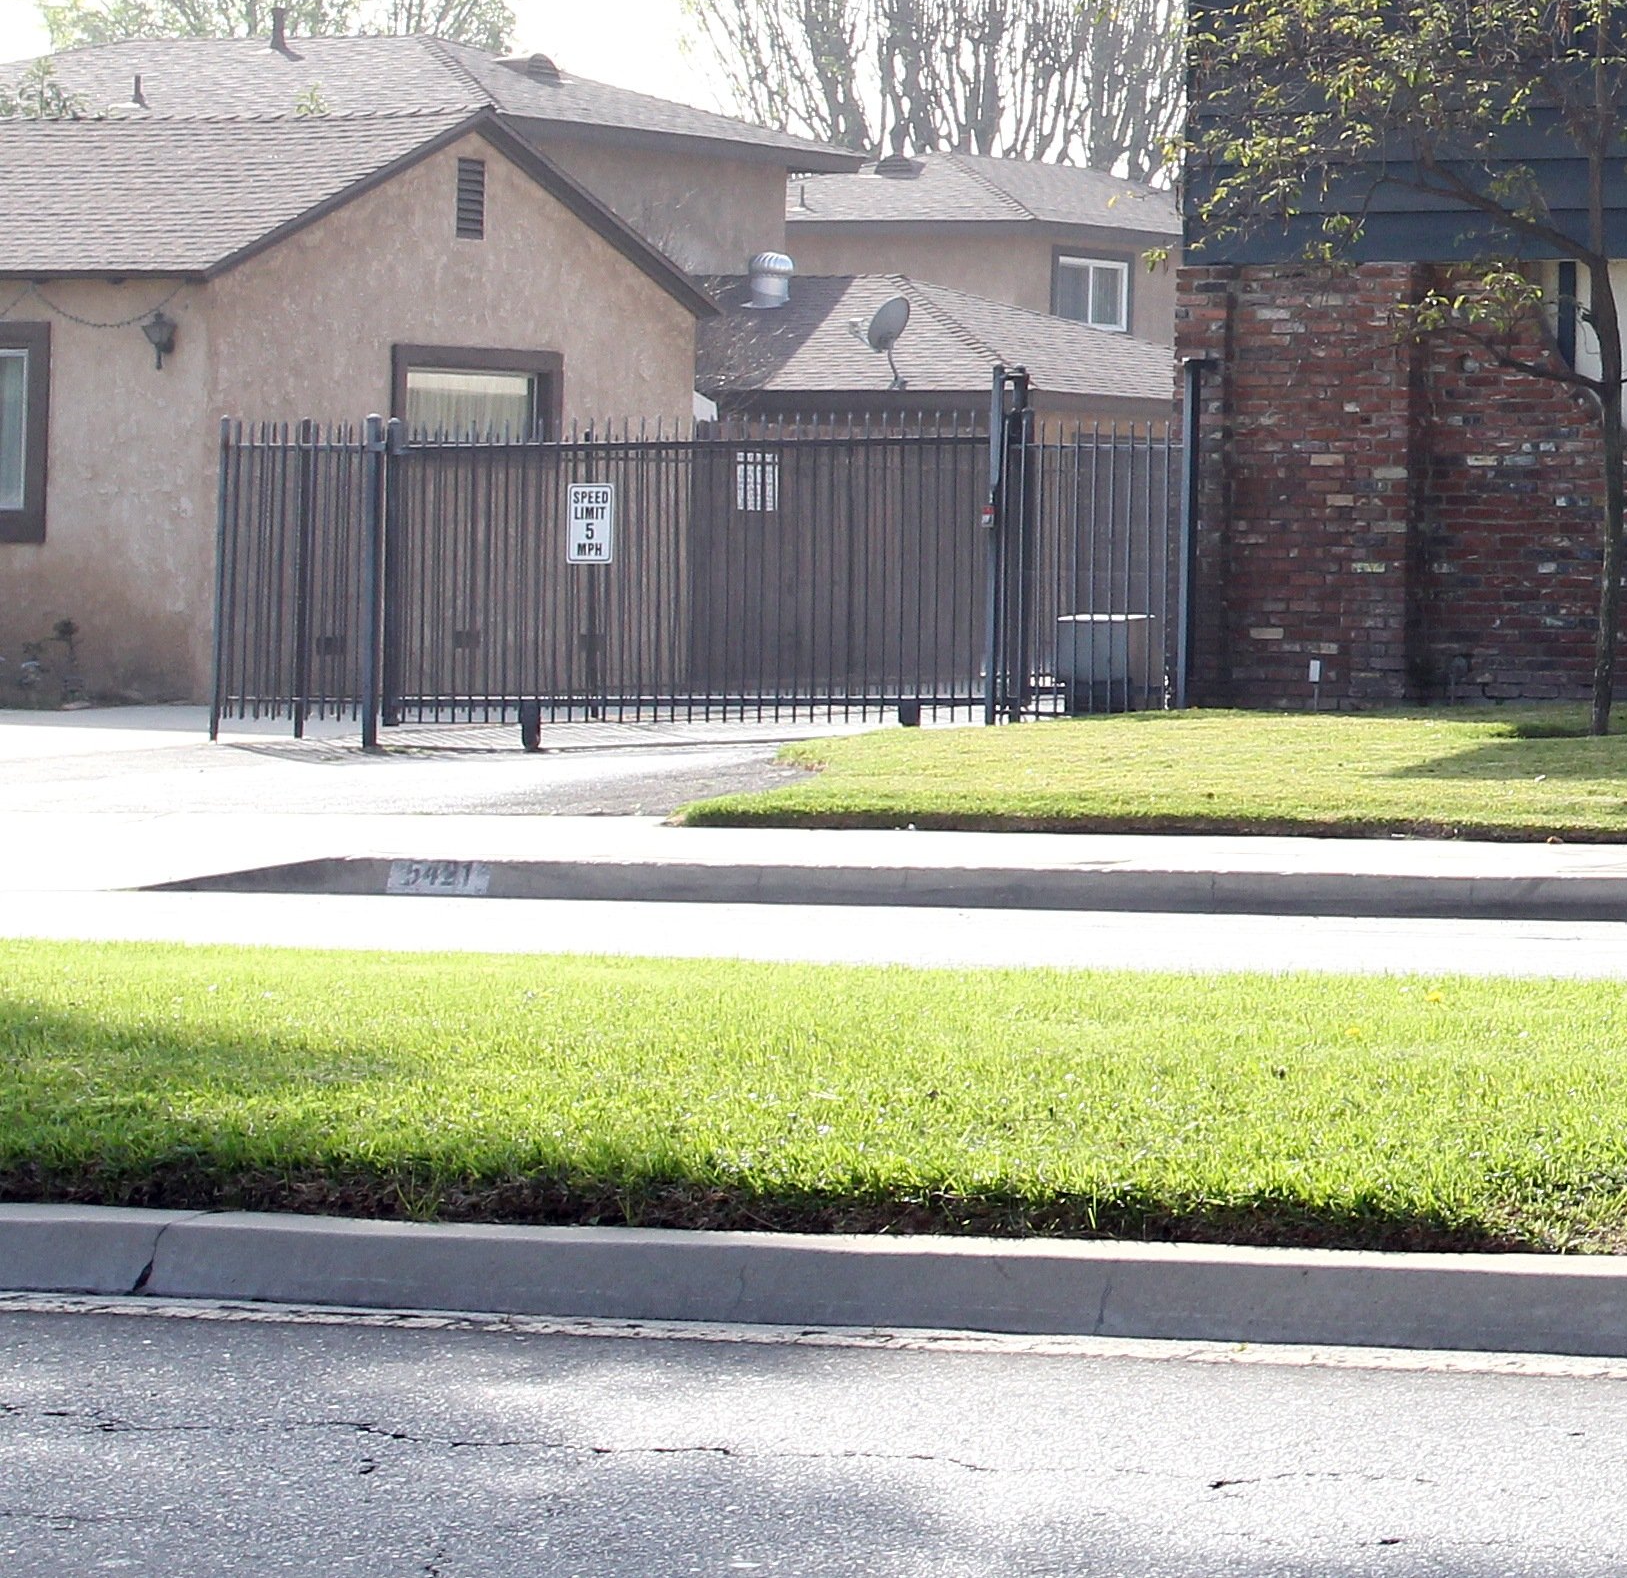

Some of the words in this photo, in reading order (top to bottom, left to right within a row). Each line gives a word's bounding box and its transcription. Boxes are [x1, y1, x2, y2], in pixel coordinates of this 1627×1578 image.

[573, 491, 608, 504] SPEED
[574, 507, 606, 520] LIMIT
[585, 522, 594, 540] 5
[577, 543, 602, 556] MPH
[400, 862, 474, 887] 5421
